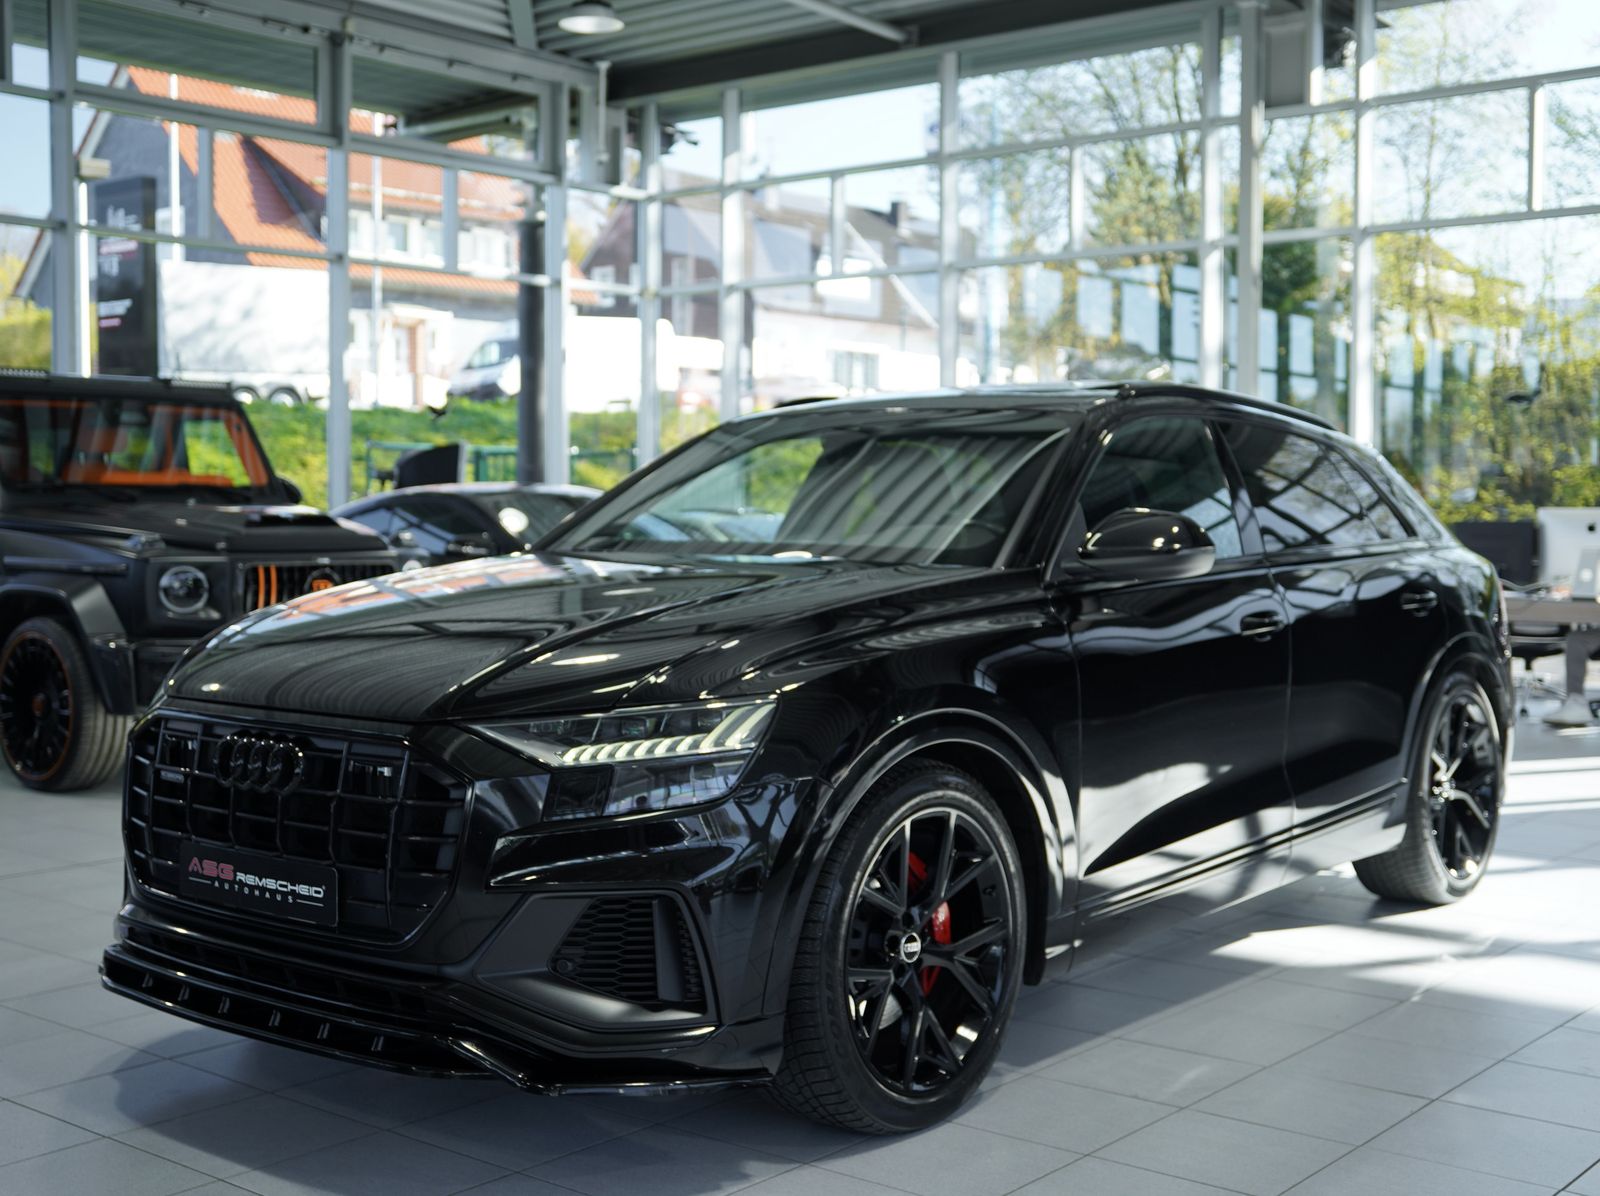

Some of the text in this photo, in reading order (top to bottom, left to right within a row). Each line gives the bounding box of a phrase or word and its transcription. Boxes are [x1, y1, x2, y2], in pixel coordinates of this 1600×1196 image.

[188, 856, 324, 899] ASG REMSCHEID
[213, 880, 294, 904] AUTOHAUS
